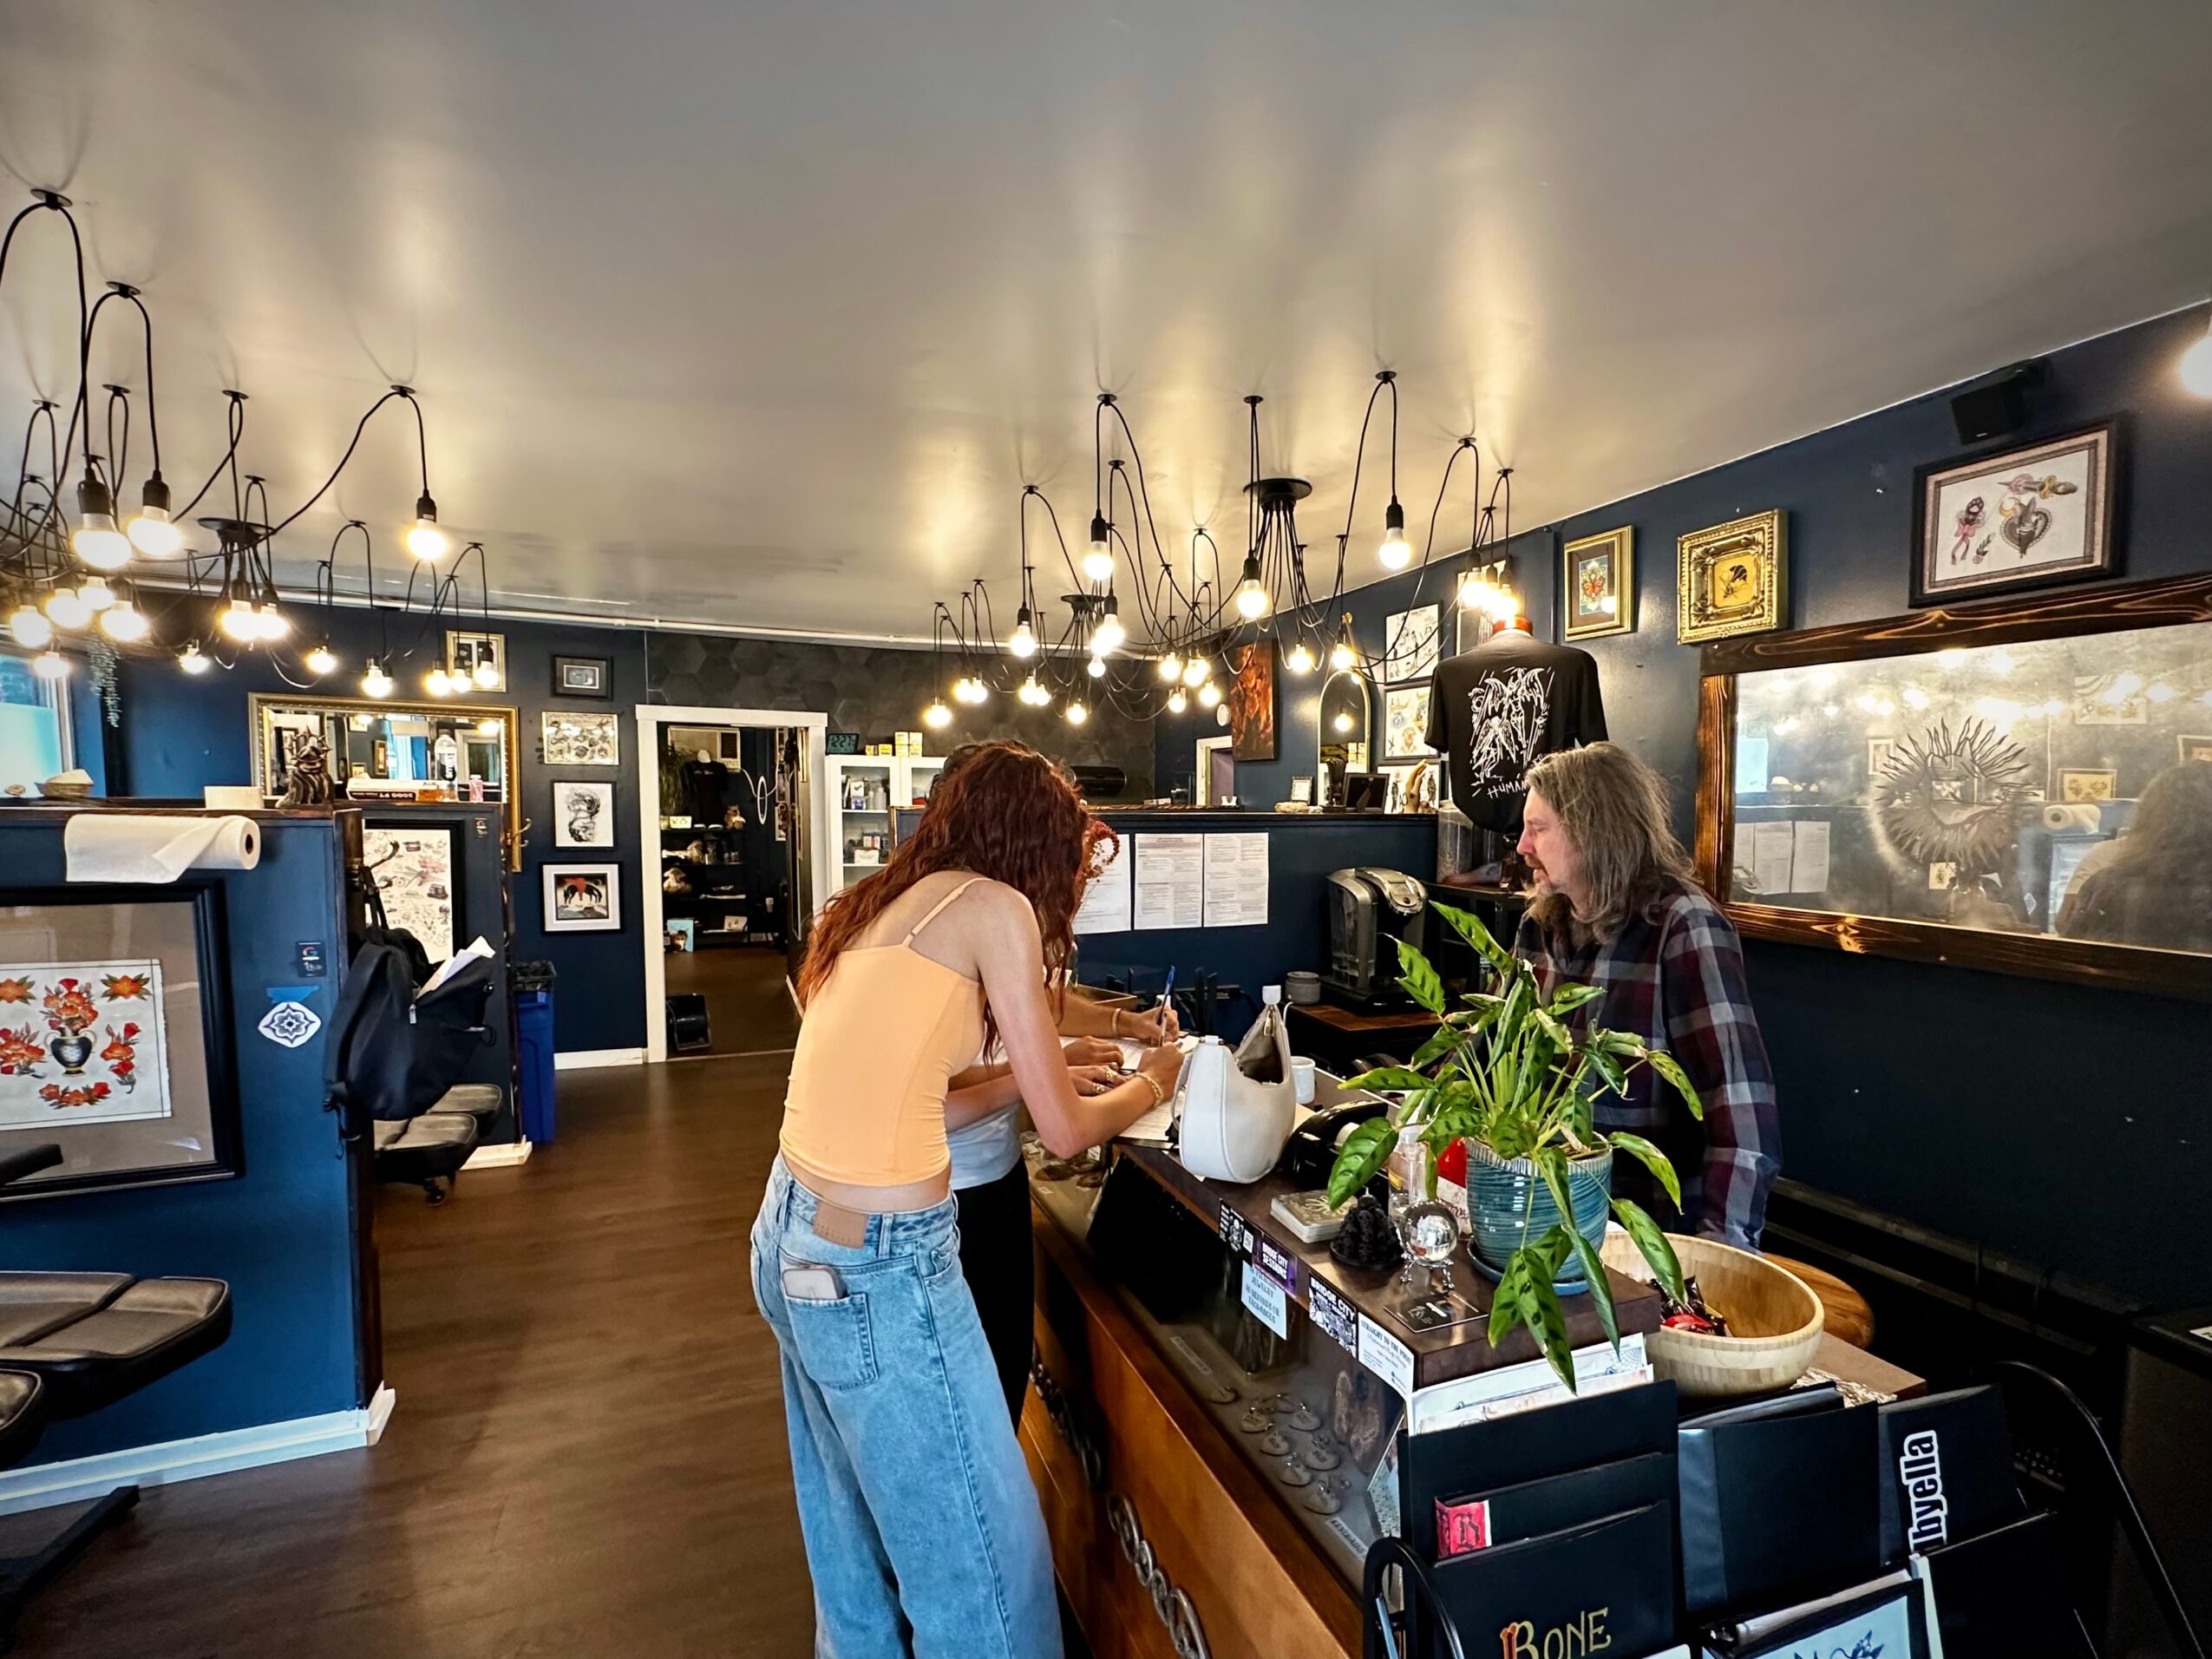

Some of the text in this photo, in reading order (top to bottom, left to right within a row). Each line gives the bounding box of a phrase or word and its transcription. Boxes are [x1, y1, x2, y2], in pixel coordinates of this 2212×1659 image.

[1310, 1276, 1337, 1305] BRIDGE
[1338, 1299, 1355, 1321] CITY
[1361, 1319, 1383, 1341] STRAIGHT
[1384, 1334, 1391, 1348] TO
[1500, 1606, 1612, 1659] BONE
